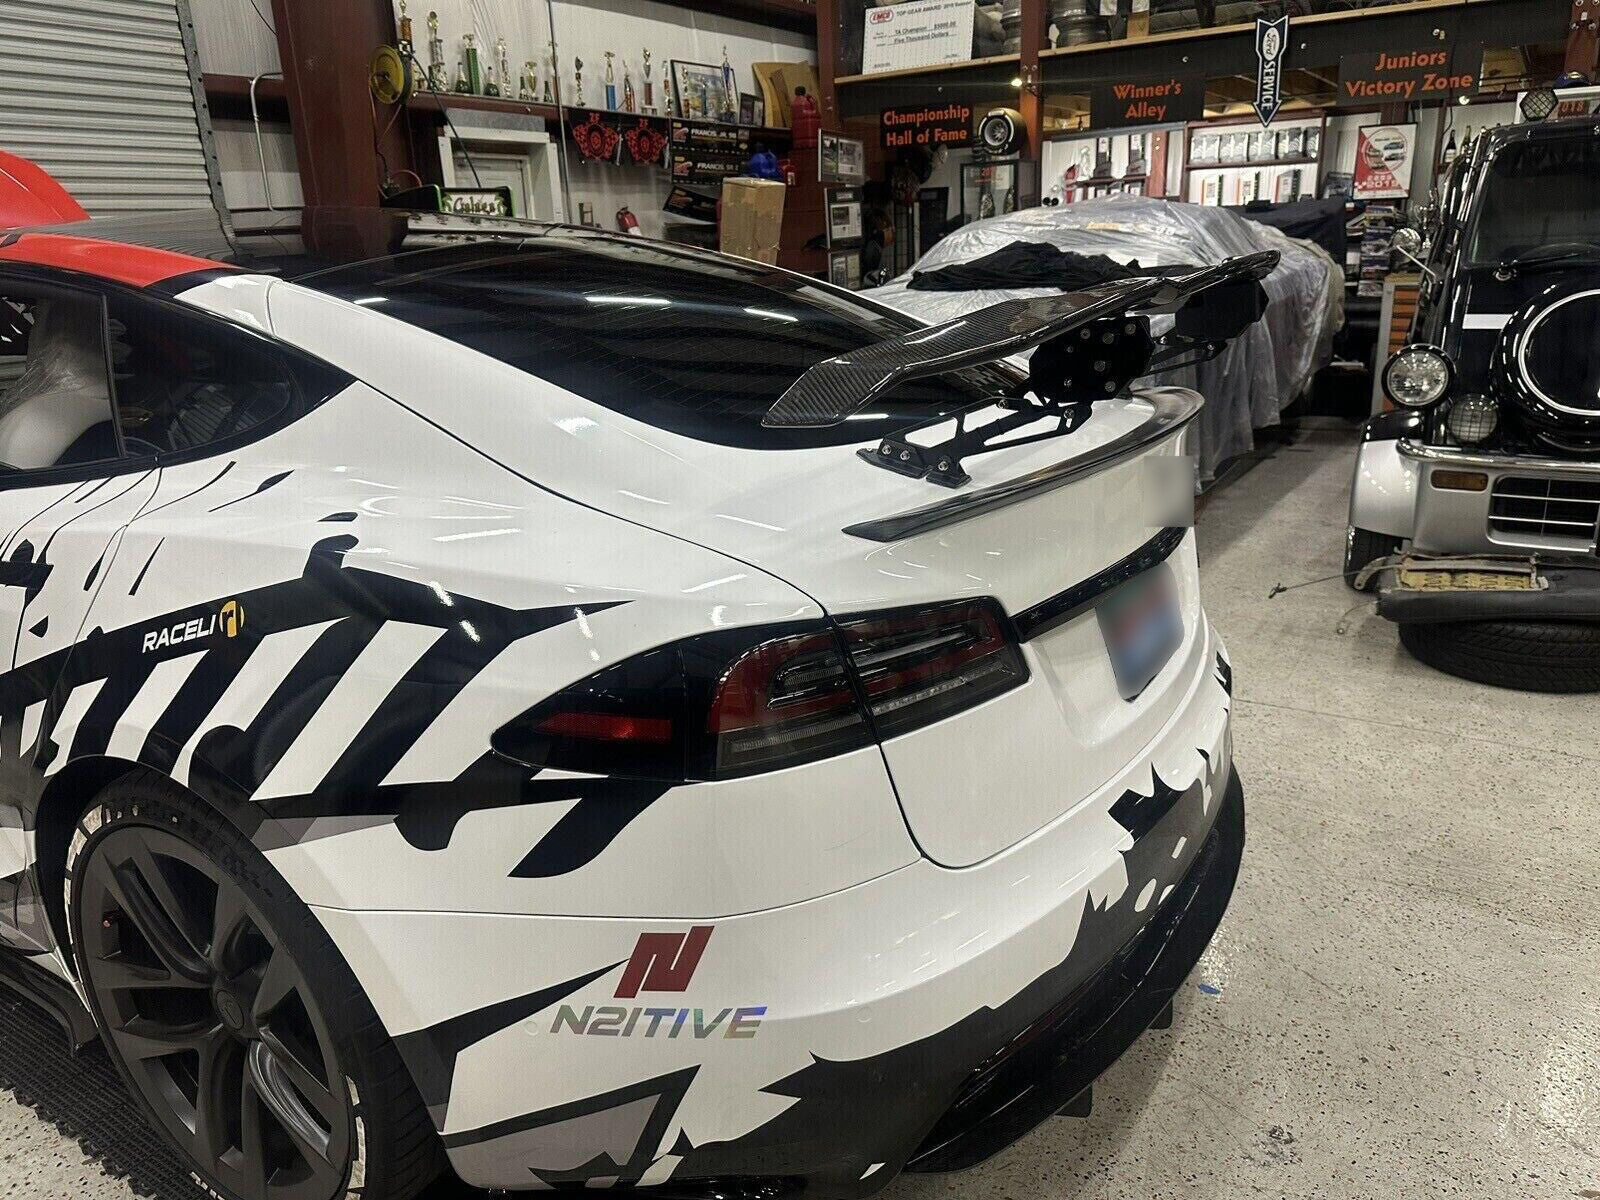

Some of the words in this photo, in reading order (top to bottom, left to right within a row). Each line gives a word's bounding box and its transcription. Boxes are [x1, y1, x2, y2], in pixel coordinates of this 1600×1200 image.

[906, 34, 930, 43] Thousand
[1375, 51, 1447, 71] Juniors
[1113, 80, 1182, 99] Winner's
[1261, 61, 1276, 110] SERVICE
[1345, 80, 1416, 98] Victory
[1421, 73, 1473, 91] Zone
[883, 104, 970, 127] Championship
[1125, 101, 1166, 121] Alley
[886, 130, 912, 146] Hall
[916, 128, 930, 143] of
[934, 128, 967, 142] Fame
[549, 1004, 768, 1040] N2ITIVE
